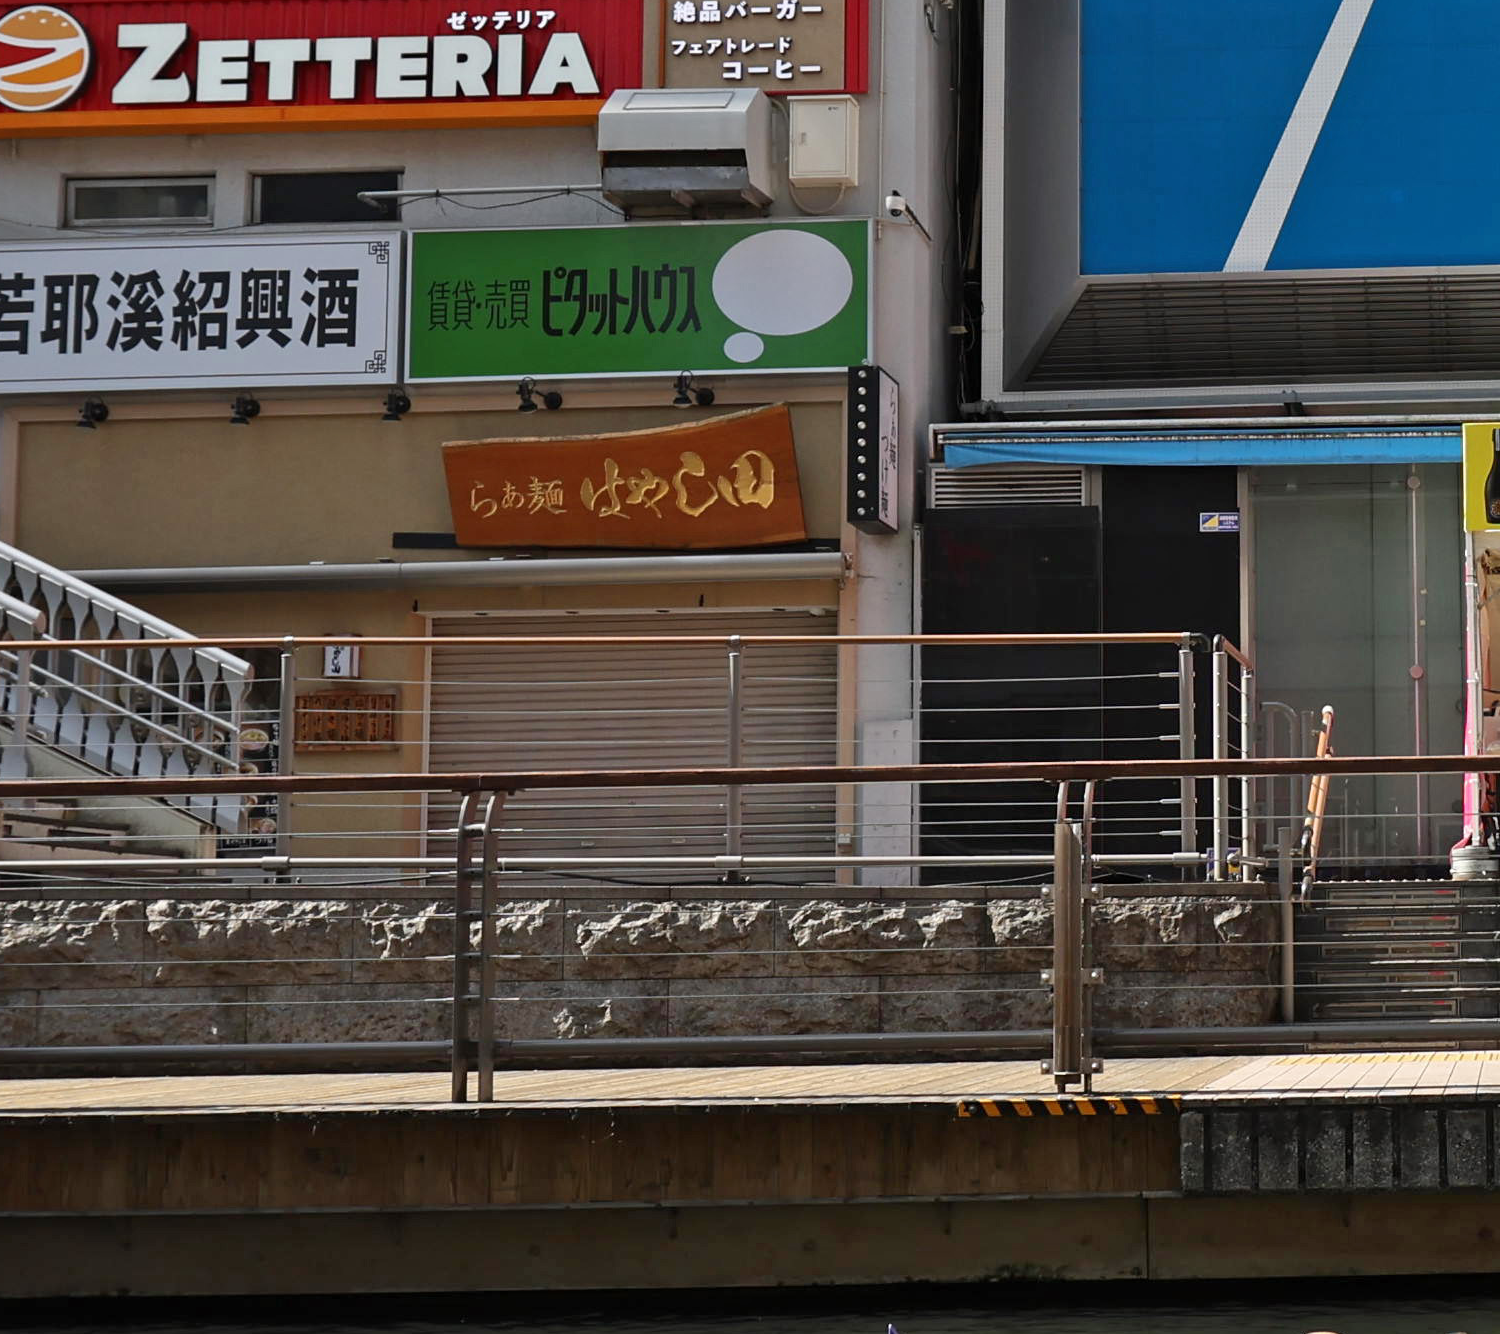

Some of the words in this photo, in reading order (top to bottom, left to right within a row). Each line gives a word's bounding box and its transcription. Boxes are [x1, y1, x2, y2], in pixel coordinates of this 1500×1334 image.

[447, 9, 556, 31] ゼッテリア
[111, 22, 600, 104] ZETTERIA
[671, 37, 792, 55] フェアトレード
[722, 59, 822, 80] コーヒー
[428, 280, 530, 330] 賃貸・売買
[543, 264, 702, 336] ピタットハウス
